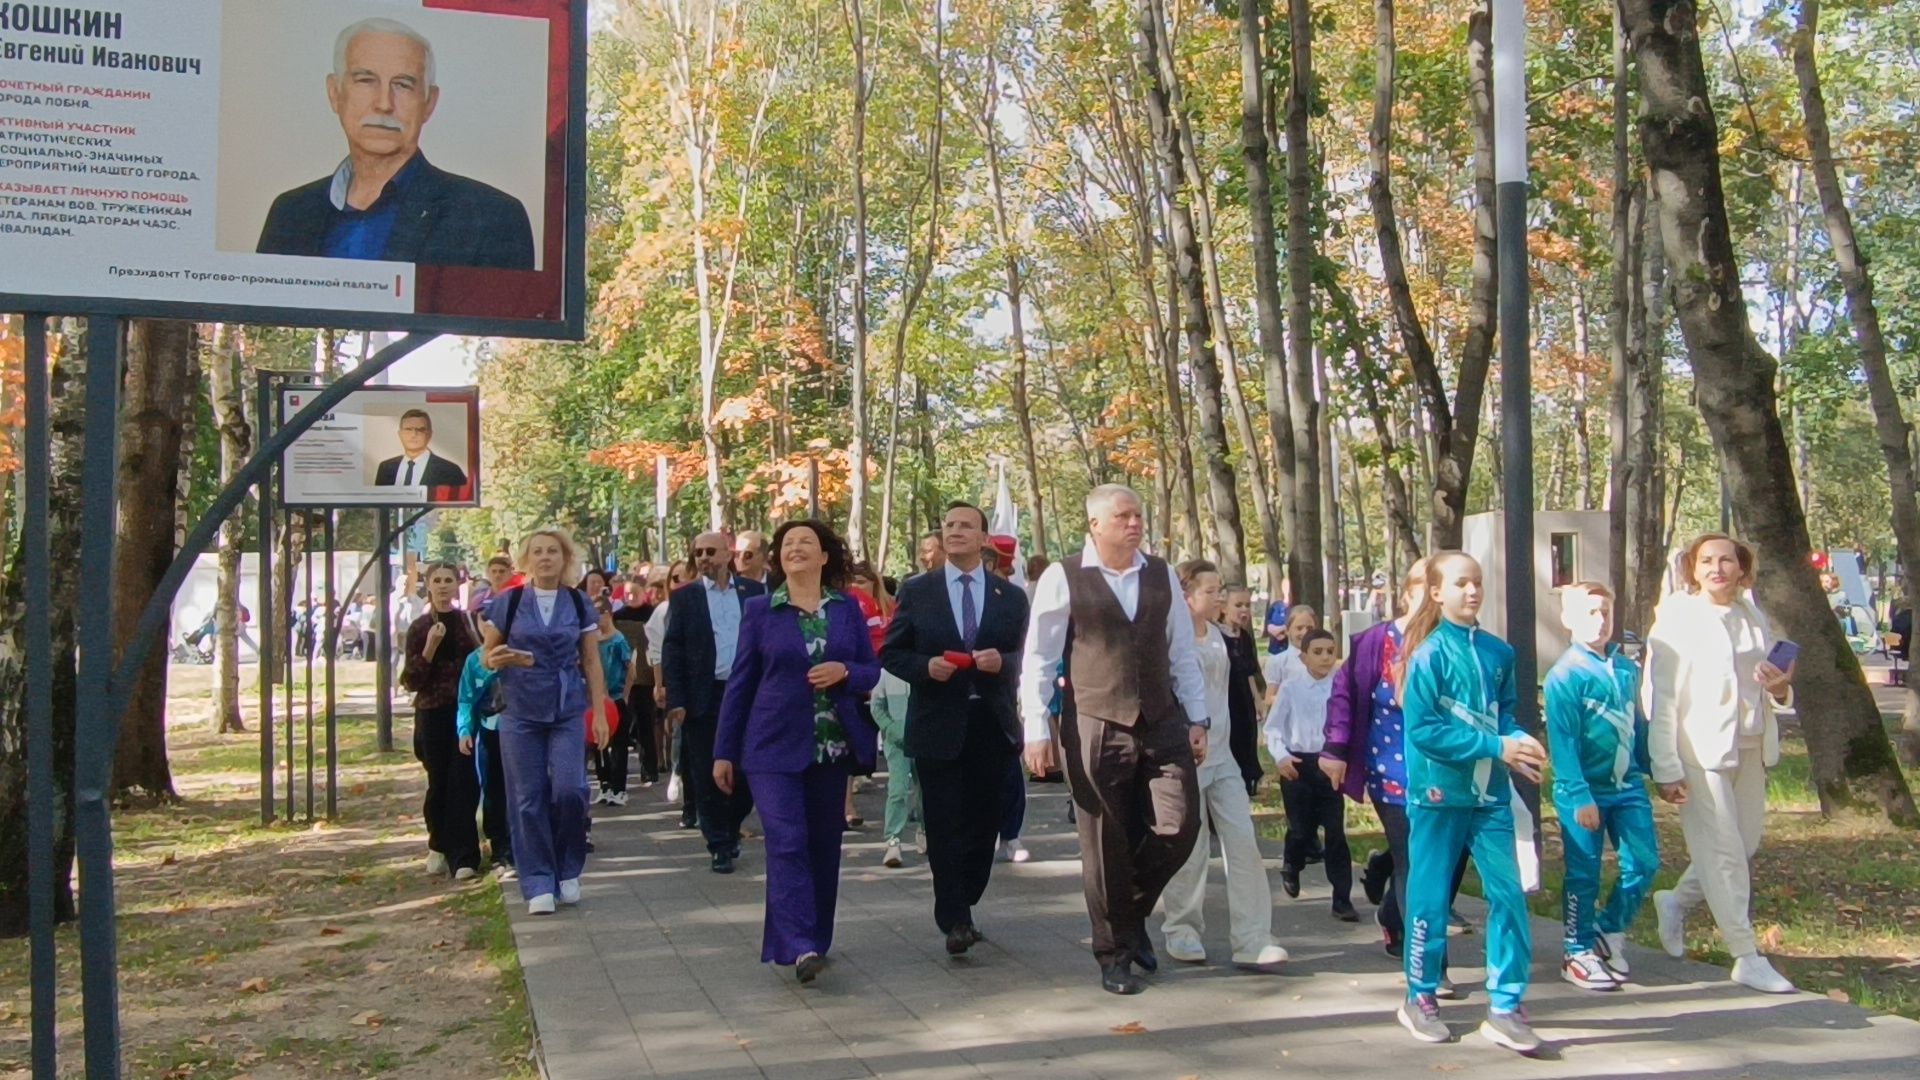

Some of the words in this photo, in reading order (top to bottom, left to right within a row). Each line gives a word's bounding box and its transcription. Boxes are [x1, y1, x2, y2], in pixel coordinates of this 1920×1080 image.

[0, 38, 84, 65] вгений
[92, 46, 200, 75] Иванович
[67, 84, 151, 99] ГРАЖДАНИН
[67, 122, 136, 136] УЧАСТНИК
[90, 166, 144, 178] НАШЕГО
[70, 187, 128, 199] ЛИЧНУЮ
[131, 190, 189, 203] ПОМОЩЬ
[0, 196, 65, 208] ТЕРАНАМ
[101, 202, 192, 216] ТРУЖЕНИКАМ
[31, 211, 140, 227] ЛИКВИДАТОРАМ
[108, 265, 181, 279] Президент
[184, 270, 340, 288] Торгово-промышленной
[342, 280, 389, 291] палаты
